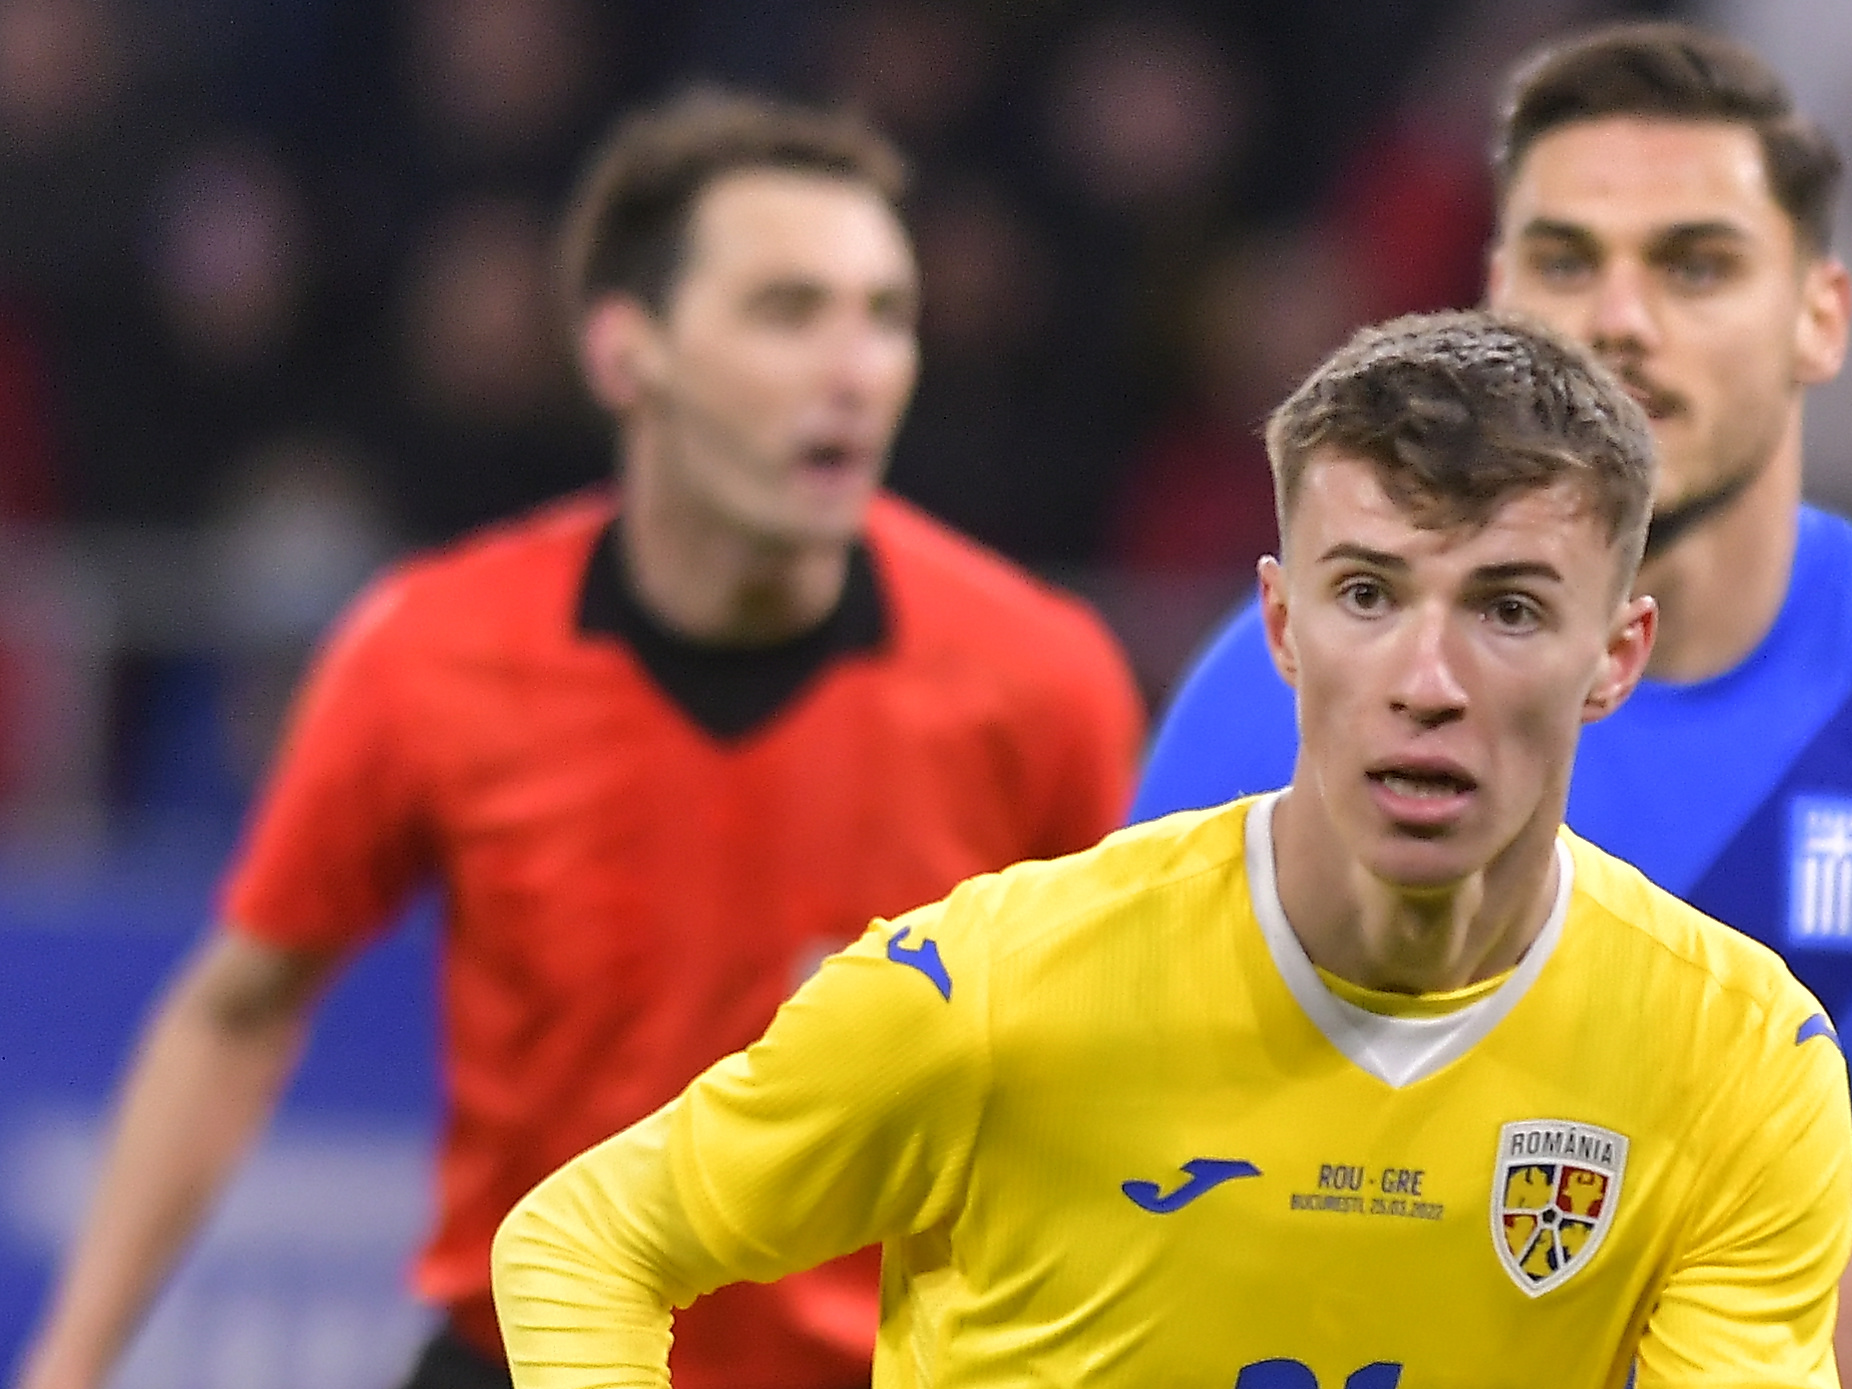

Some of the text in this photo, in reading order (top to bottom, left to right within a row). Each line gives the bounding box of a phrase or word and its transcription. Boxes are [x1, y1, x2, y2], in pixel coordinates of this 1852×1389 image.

[1510, 1126, 1614, 1163] ROMÂNIA
[1318, 1163, 1364, 1192] ROU
[1380, 1167, 1426, 1197] GRE
